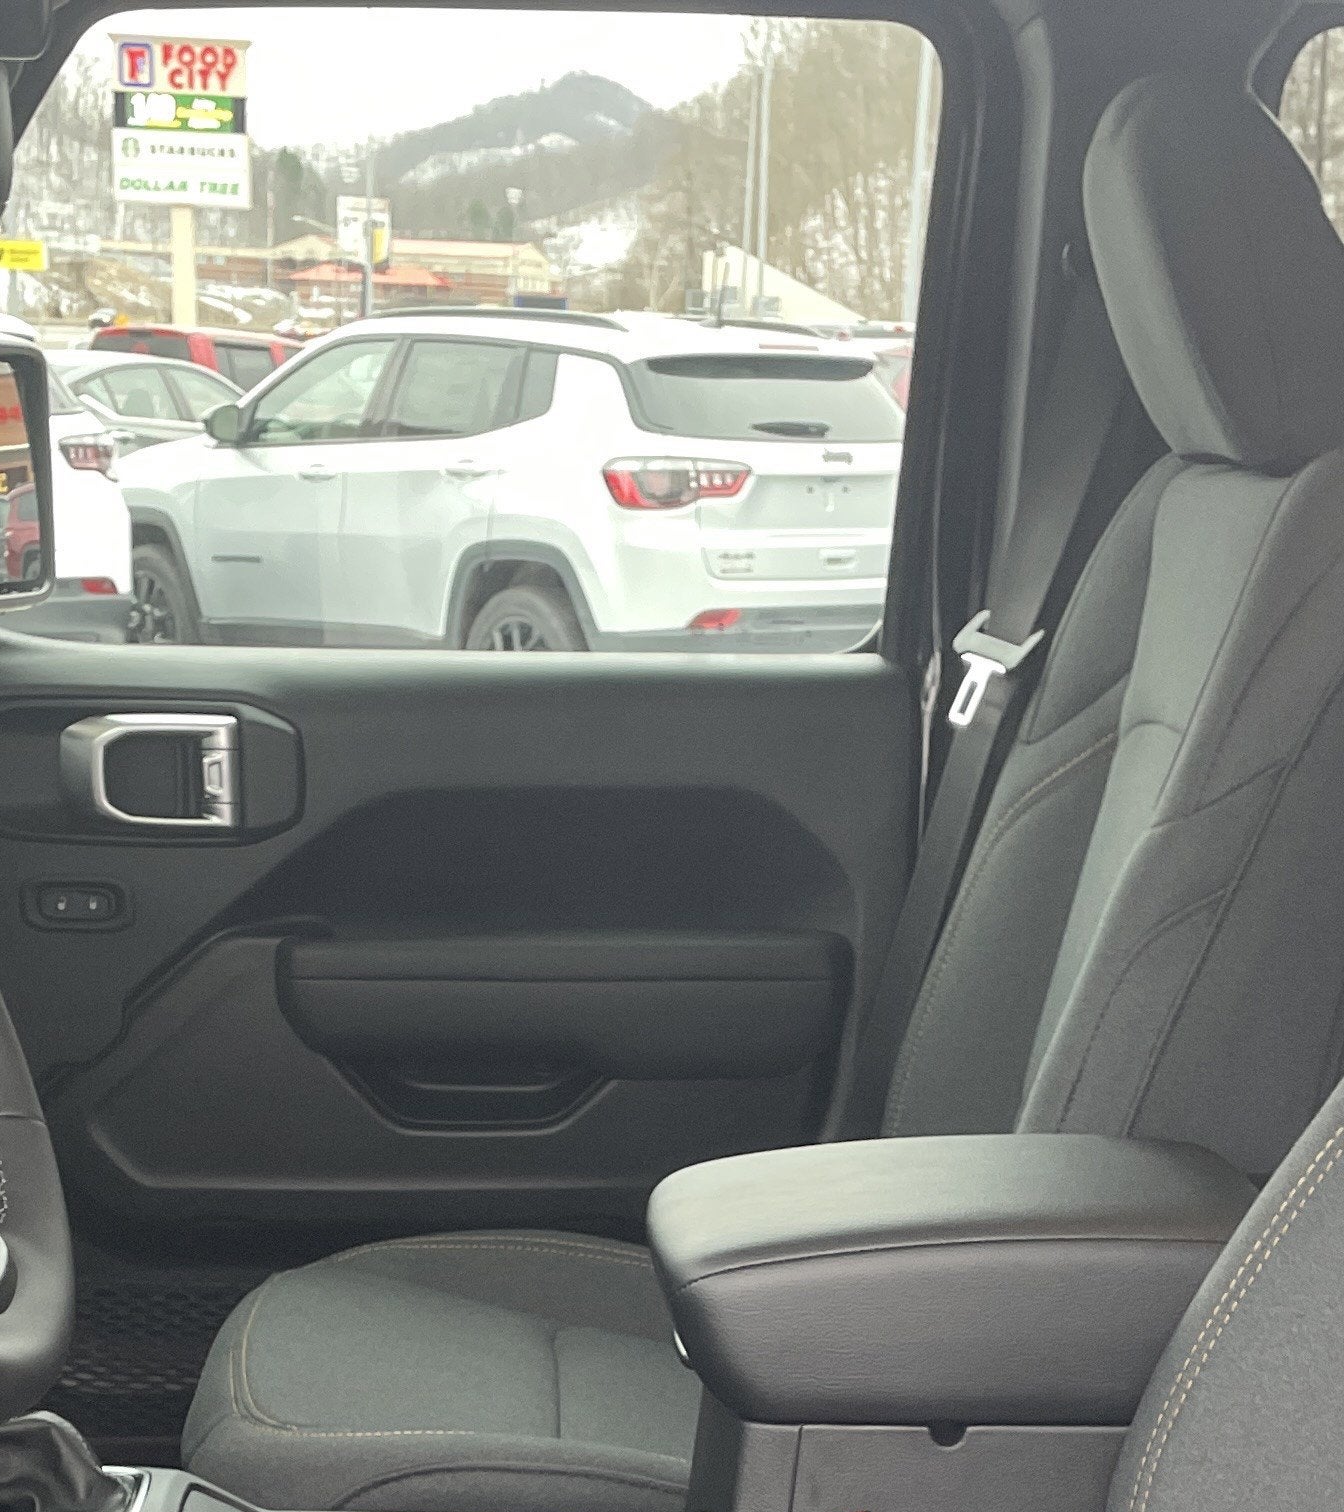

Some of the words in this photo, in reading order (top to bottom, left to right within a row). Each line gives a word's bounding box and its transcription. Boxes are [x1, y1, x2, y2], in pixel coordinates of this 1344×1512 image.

[161, 43, 236, 69] FOOD
[168, 68, 233, 91] CITY
[119, 177, 188, 192] DOLLAR
